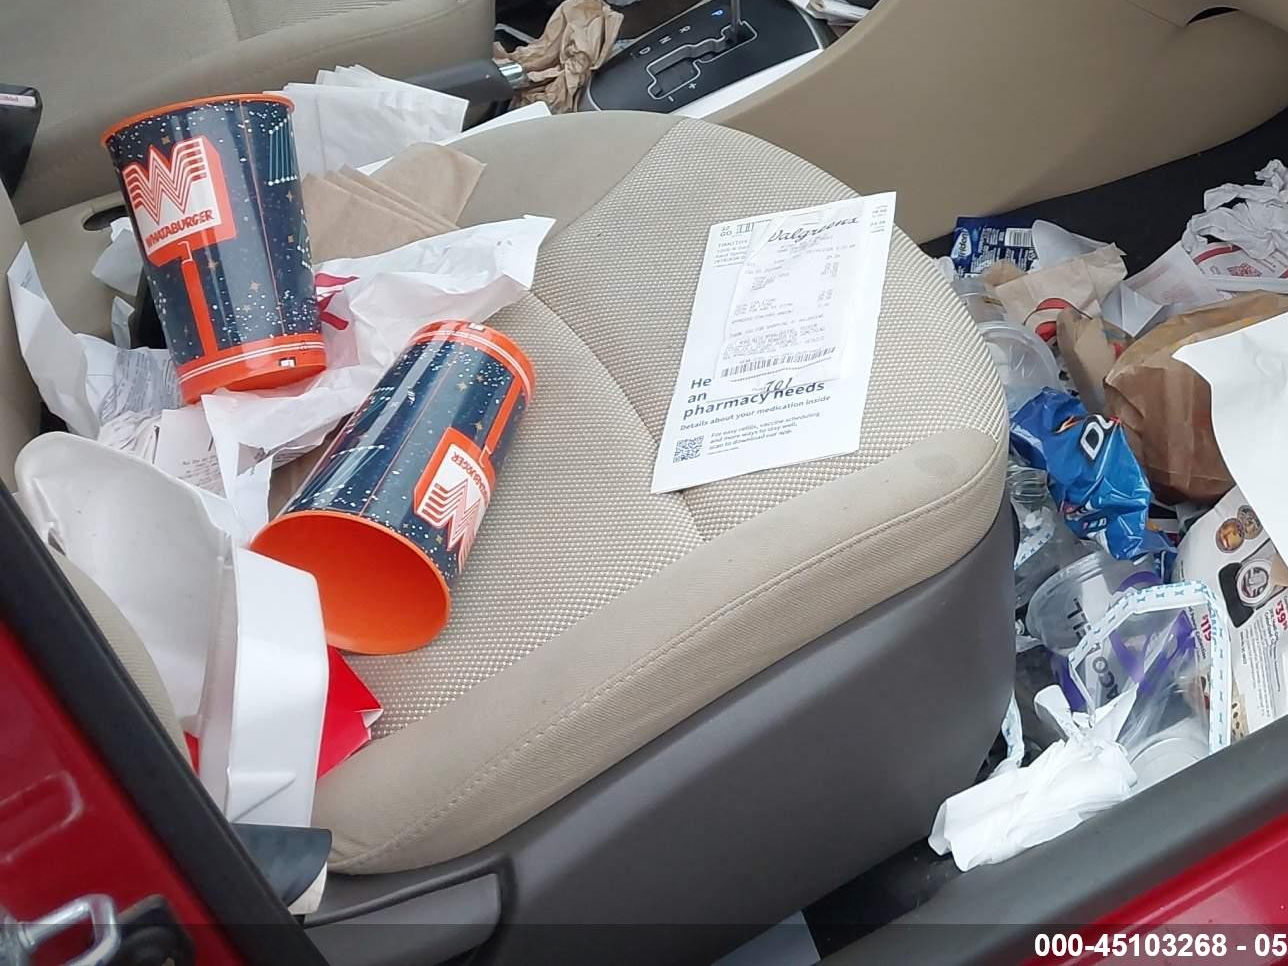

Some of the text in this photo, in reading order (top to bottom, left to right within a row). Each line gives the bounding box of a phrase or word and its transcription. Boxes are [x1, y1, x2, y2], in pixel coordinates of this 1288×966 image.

[145, 209, 215, 249] WHATABURGER
[680, 395, 831, 431] Details about your medication inside
[682, 381, 825, 421] pharmacy needs
